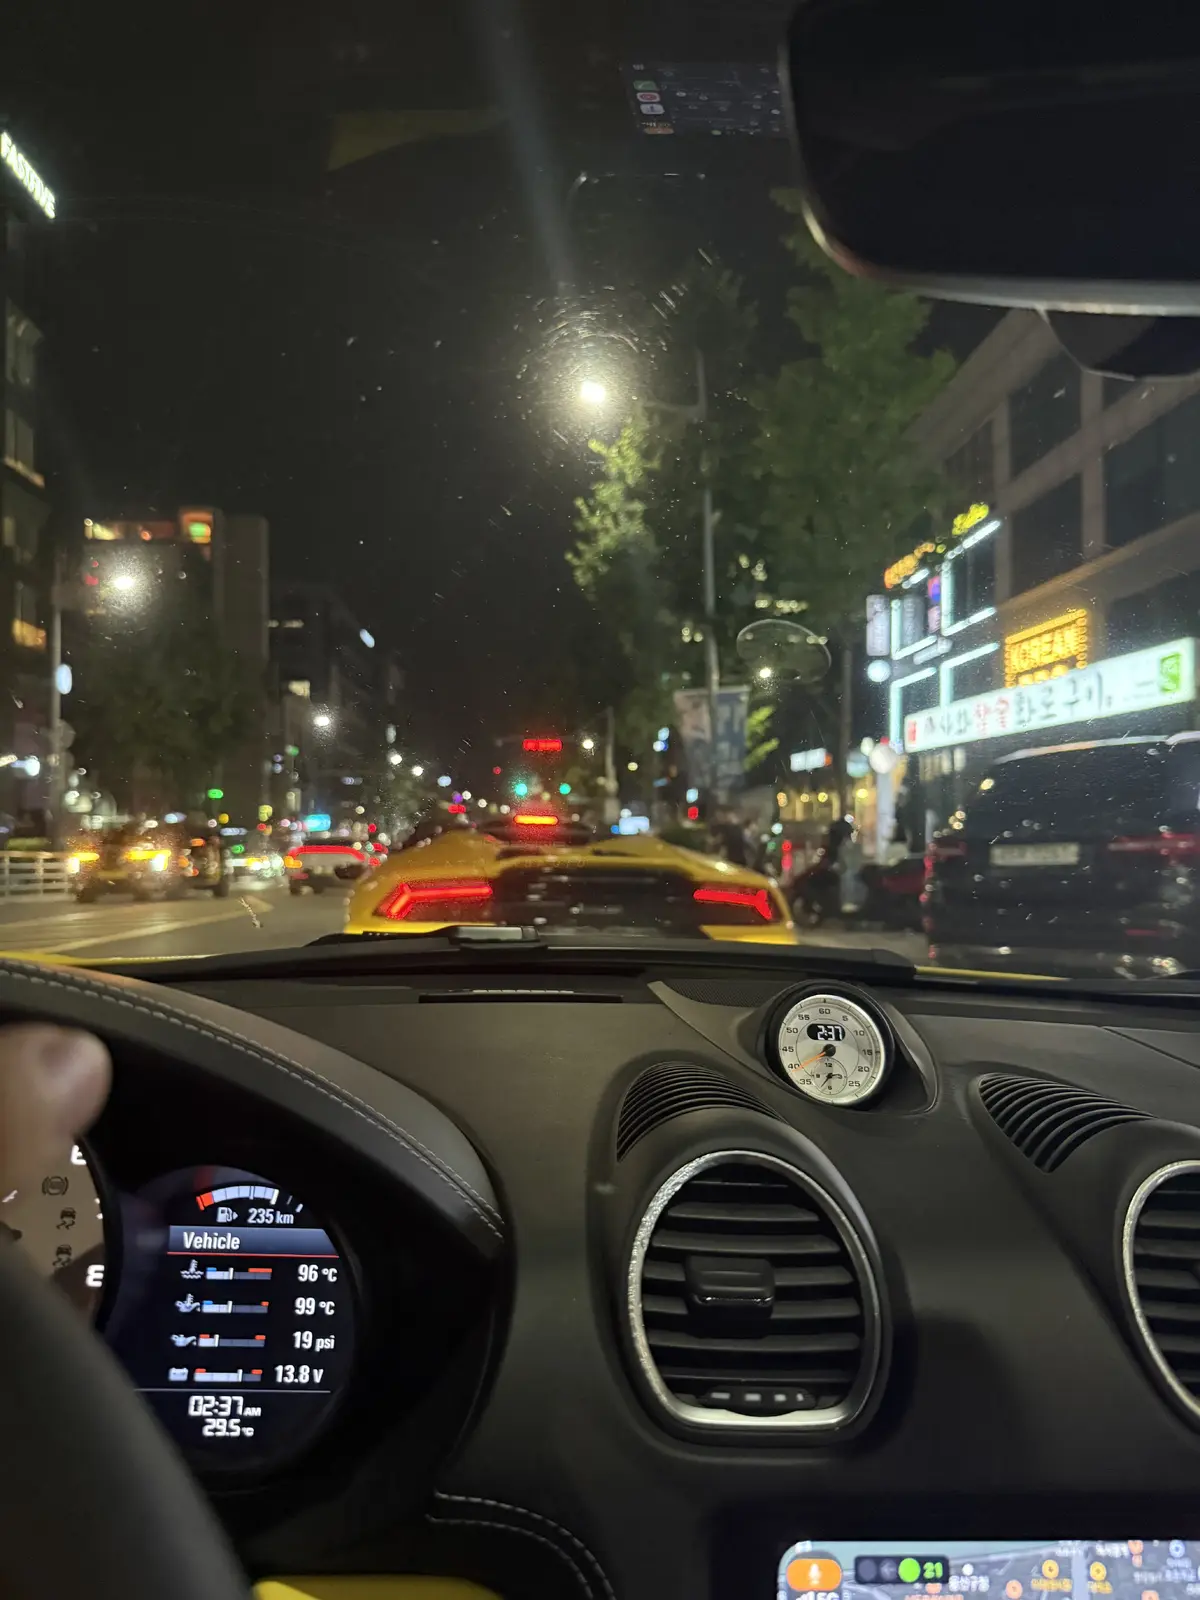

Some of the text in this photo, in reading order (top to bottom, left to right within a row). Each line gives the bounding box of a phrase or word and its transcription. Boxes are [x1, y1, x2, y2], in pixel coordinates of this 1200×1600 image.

[817, 1025, 843, 1041] 2:37
[247, 1208, 295, 1225] 235 km
[183, 1231, 241, 1251] Vehicle
[297, 1264, 319, 1283] 96
[294, 1297, 316, 1316] 99
[293, 1331, 335, 1352] 19 psi
[274, 1364, 310, 1384] 13.8
[923, 1561, 944, 1579] 21
